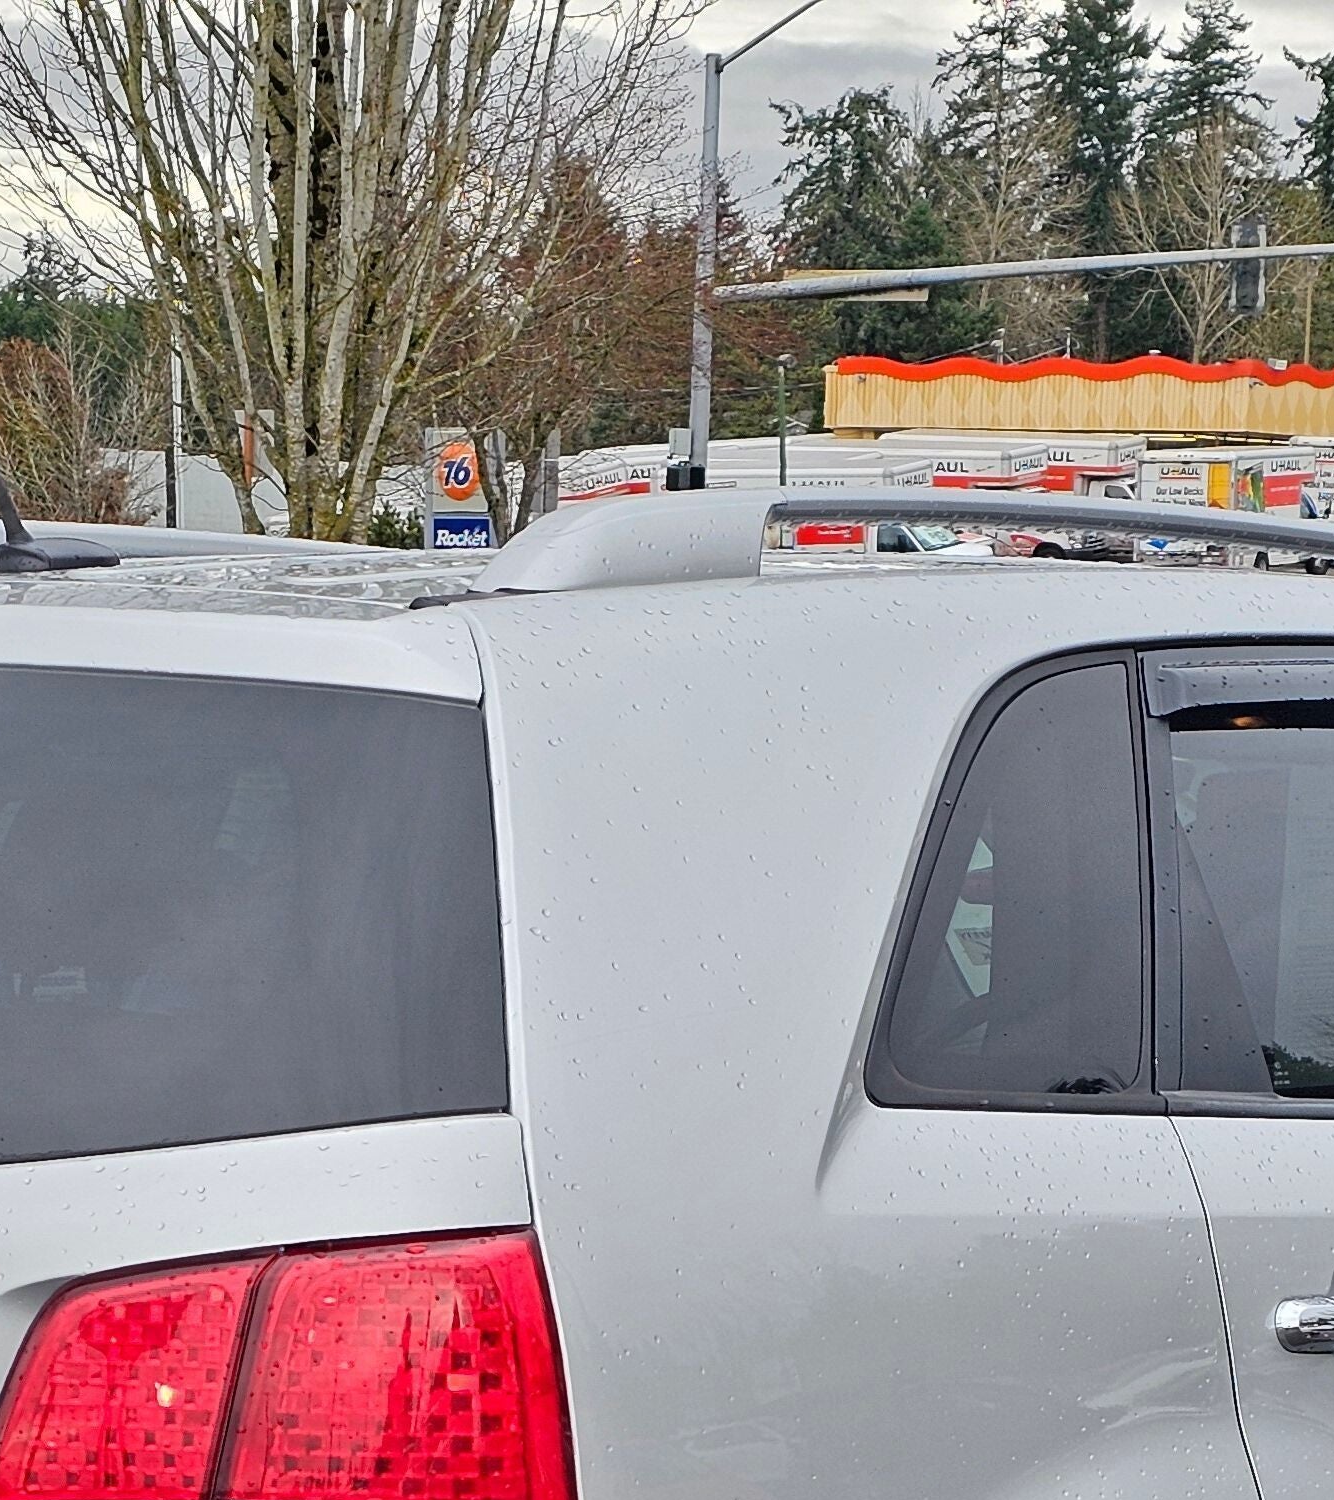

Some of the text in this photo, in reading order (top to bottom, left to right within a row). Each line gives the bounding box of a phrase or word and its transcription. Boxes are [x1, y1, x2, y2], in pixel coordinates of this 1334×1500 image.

[442, 457, 471, 488] 76
[934, 461, 969, 473] AUL
[435, 528, 488, 548] Rocket
